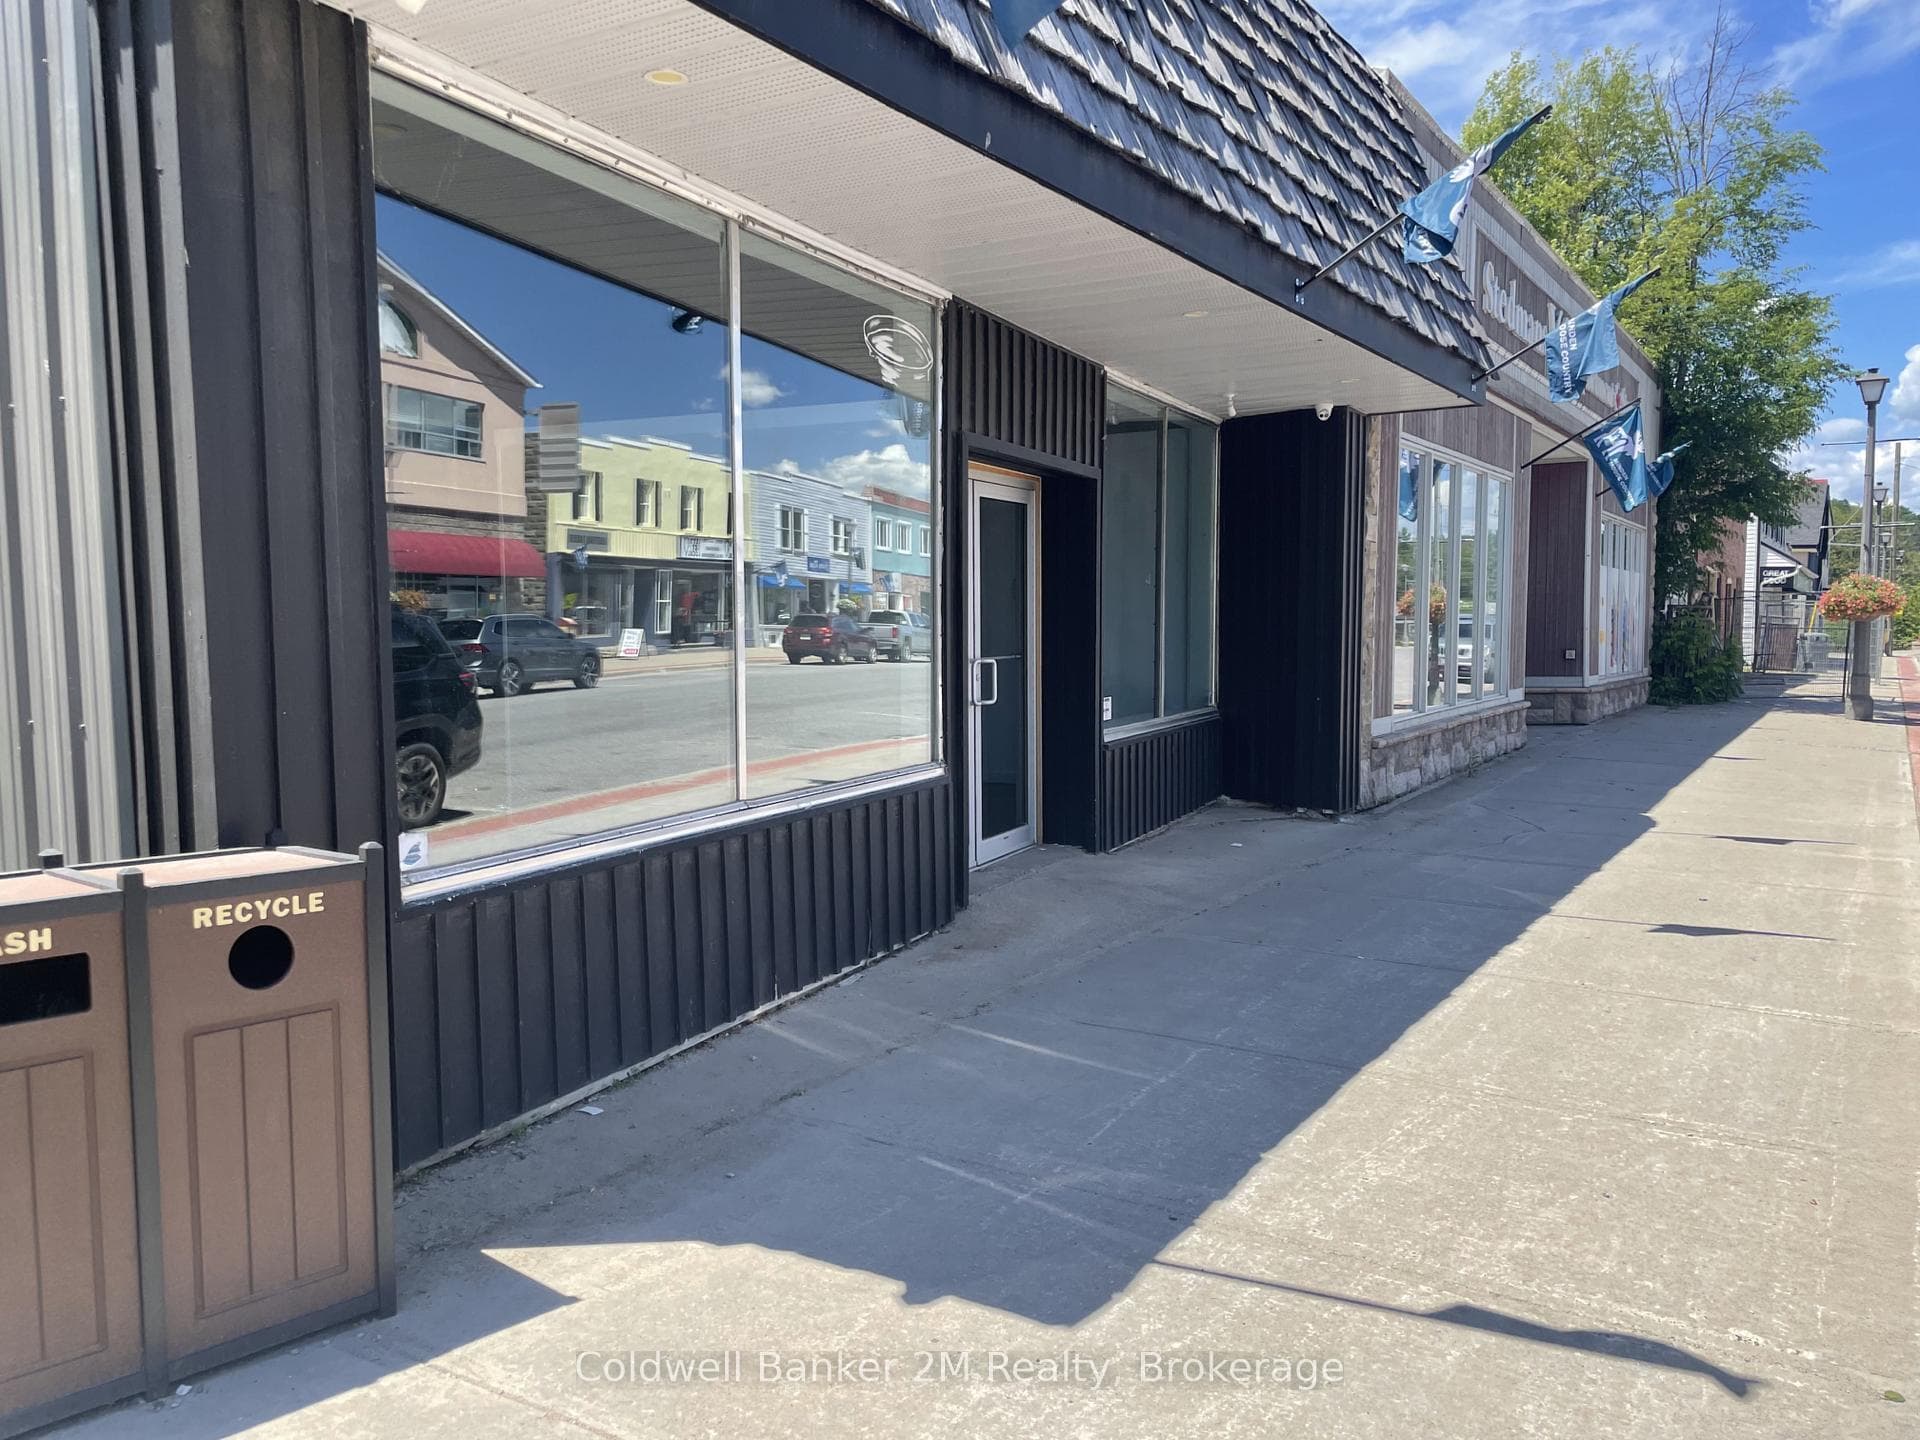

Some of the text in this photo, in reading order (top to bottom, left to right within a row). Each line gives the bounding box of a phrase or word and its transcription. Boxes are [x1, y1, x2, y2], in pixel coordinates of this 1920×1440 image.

[1561, 350, 1573, 393] COUNTRY
[1762, 569, 1790, 577] GREAT
[193, 891, 325, 929] RECYCLE
